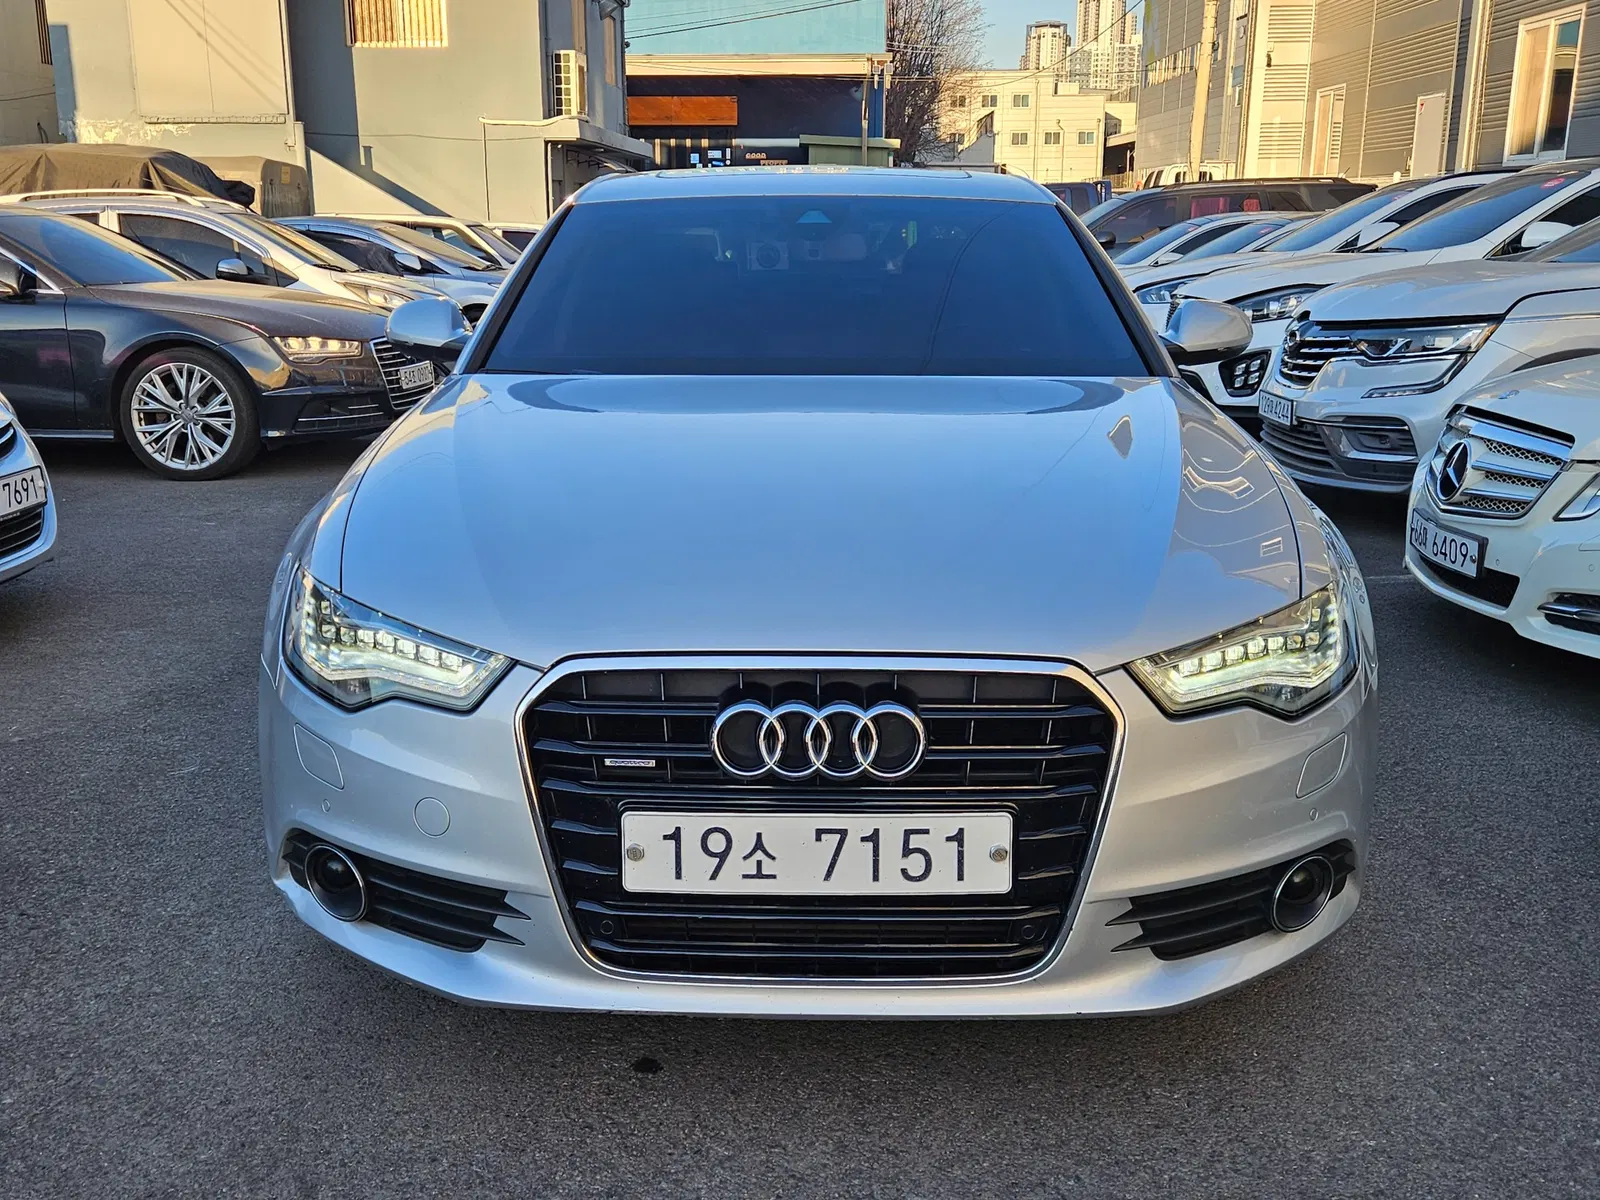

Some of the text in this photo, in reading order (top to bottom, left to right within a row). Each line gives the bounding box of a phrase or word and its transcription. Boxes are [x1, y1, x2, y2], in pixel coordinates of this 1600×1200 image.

[2, 475, 38, 508] 7691
[1432, 532, 1469, 568] 6409
[662, 826, 965, 882] 19소 7151
